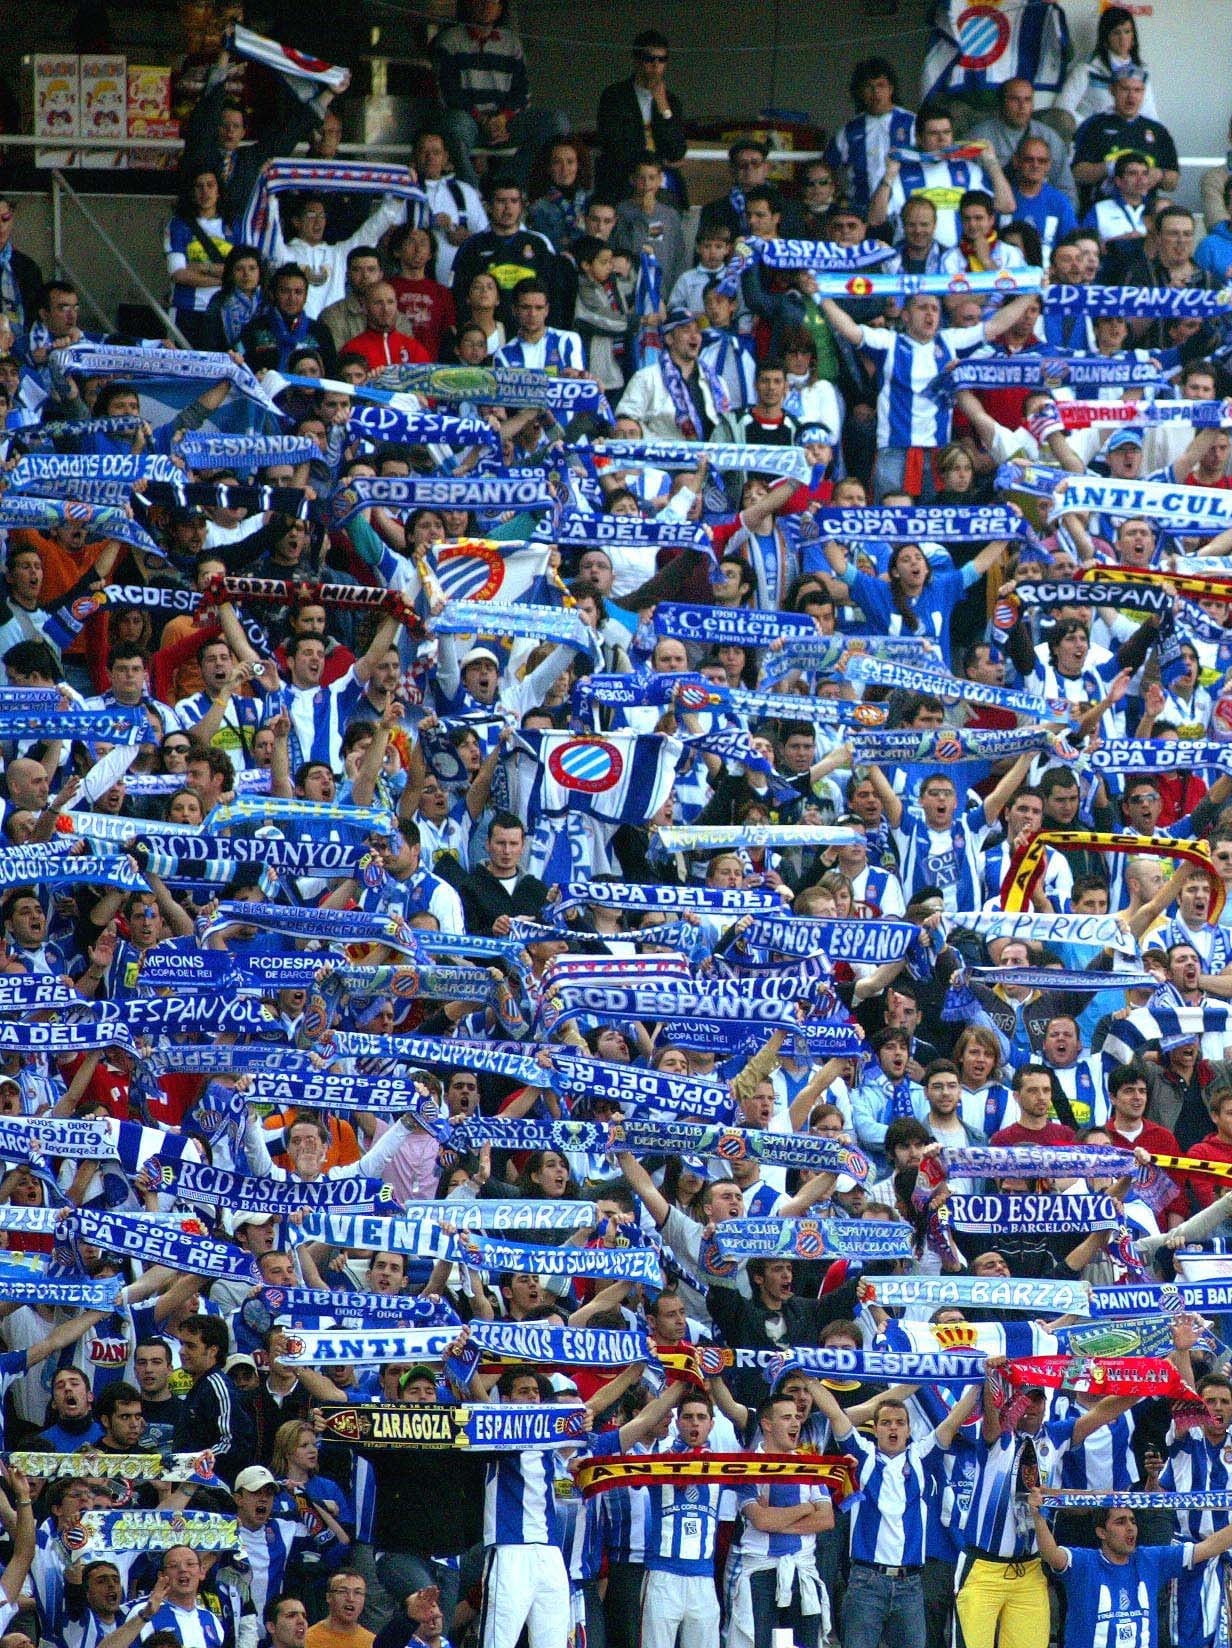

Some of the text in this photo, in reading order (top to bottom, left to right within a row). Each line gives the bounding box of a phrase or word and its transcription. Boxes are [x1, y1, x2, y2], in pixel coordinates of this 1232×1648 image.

[1086, 285, 1225, 305] ESPANYOL
[1070, 361, 1131, 382] ESPANYOL
[357, 482, 550, 504] RCD ESPANYOL
[823, 518, 1022, 535] COPA DEL REY
[226, 579, 393, 607] FORZA MILAN
[1160, 751, 1212, 767] DEL
[76, 815, 137, 839] PUTA
[216, 837, 358, 870] ESPANYOL
[570, 881, 719, 906] COPA DEL
[127, 998, 264, 1023] ESPANYOL
[562, 987, 795, 1025] RCD ESPANYOL
[29, 1028, 87, 1044] DEL
[301, 1086, 355, 1102] DEL
[605, 1070, 658, 1096] DEL
[666, 1125, 702, 1139] CLUB
[179, 1162, 374, 1206] RCD ESPANYOL
[491, 1205, 596, 1229] BARZA
[953, 1196, 1002, 1223] RCD
[746, 1223, 781, 1236] CLUB
[991, 1222, 1089, 1233] De BARCELONA
[121, 1231, 246, 1274] DEL REY
[838, 1238, 909, 1251] BARCELONA
[882, 1282, 1075, 1307] PUTA BARZA
[1184, 1289, 1204, 1307] DE
[793, 1349, 857, 1369] RCD
[1107, 1366, 1169, 1384] MILAN
[372, 1412, 551, 1442] ZARAGOZA ESPANYOL
